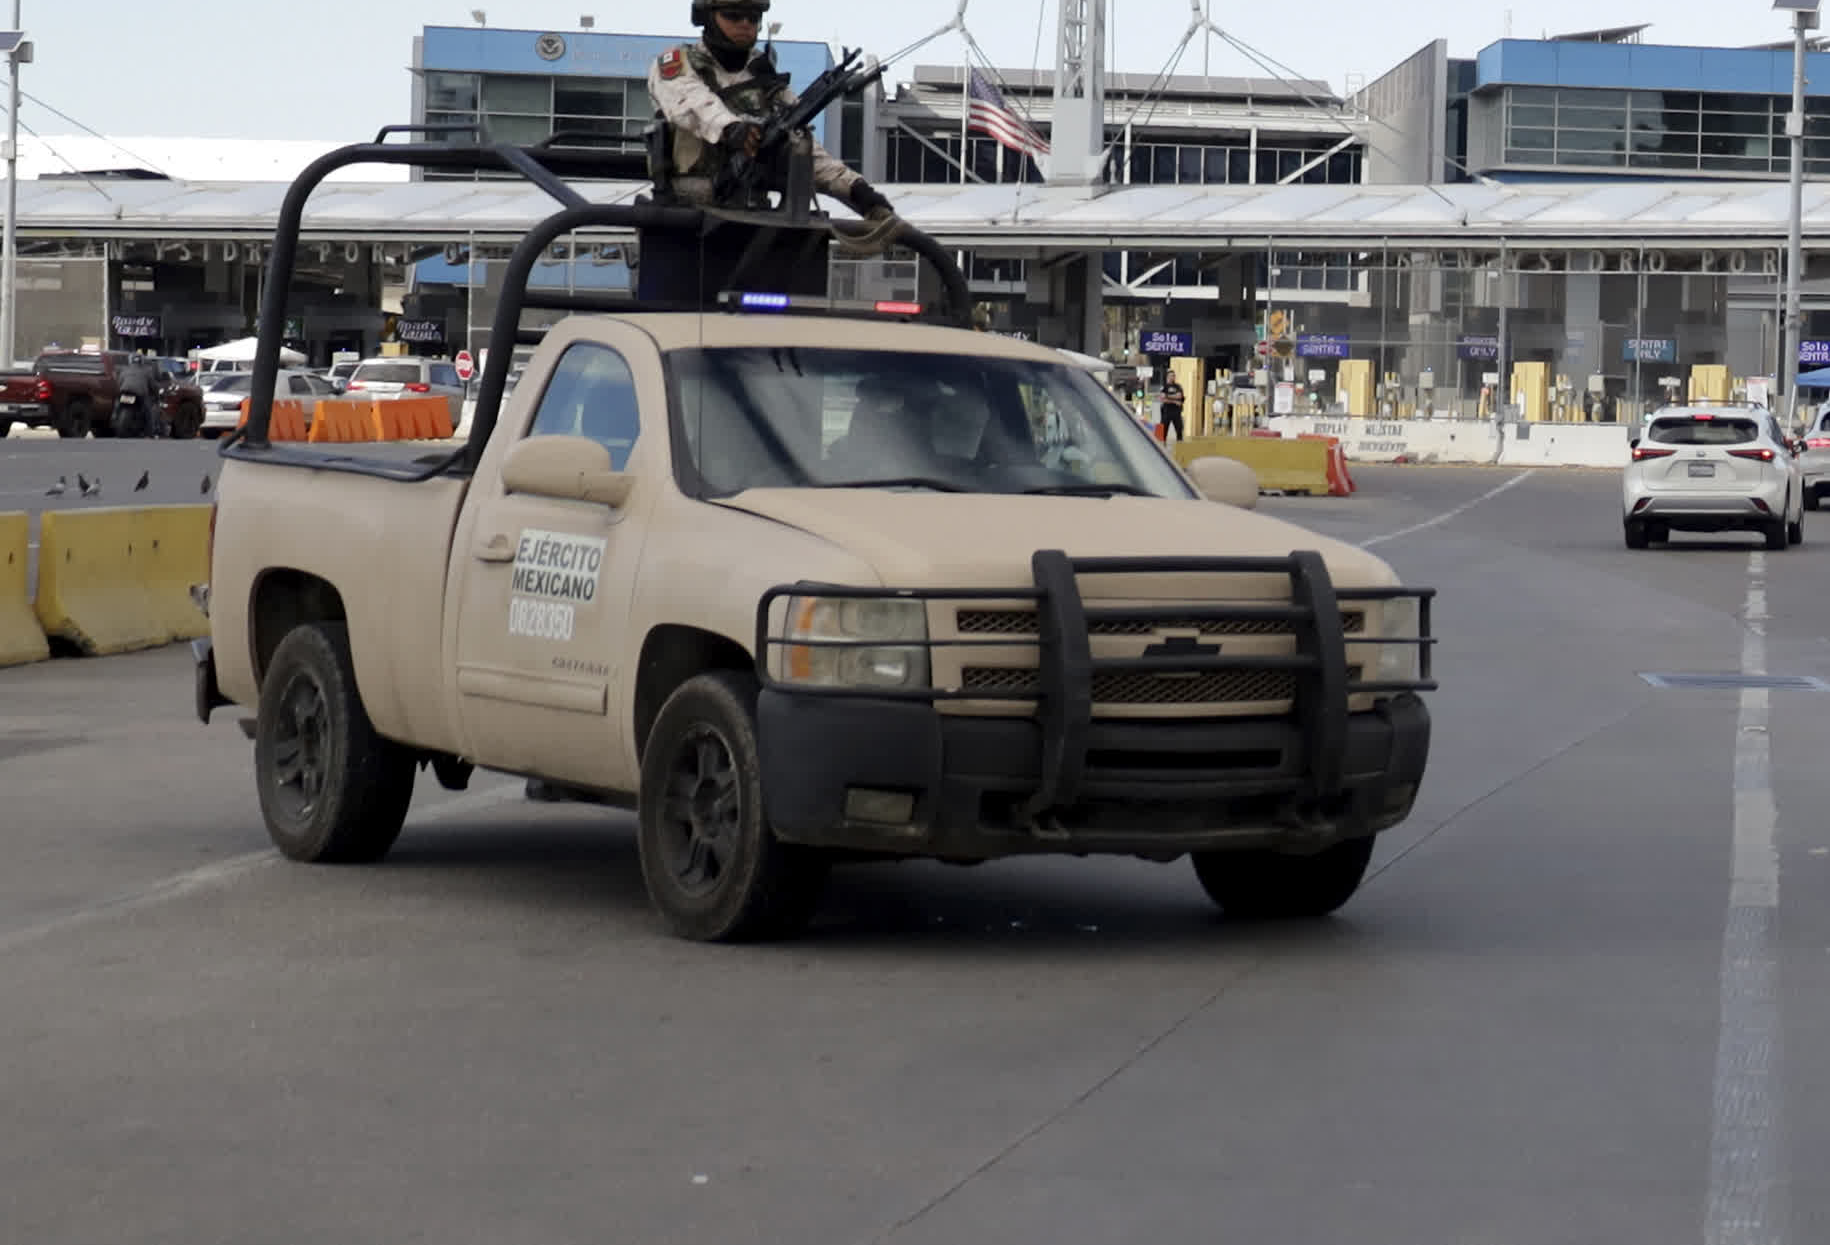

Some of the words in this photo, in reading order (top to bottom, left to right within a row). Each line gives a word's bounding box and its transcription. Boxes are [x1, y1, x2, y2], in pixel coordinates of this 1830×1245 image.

[1152, 332, 1178, 342] Solo
[1145, 342, 1184, 352] SENTRI
[1801, 341, 1829, 352] Solo
[517, 534, 602, 573] EJÉRCITO
[512, 567, 596, 601] MEXICANO
